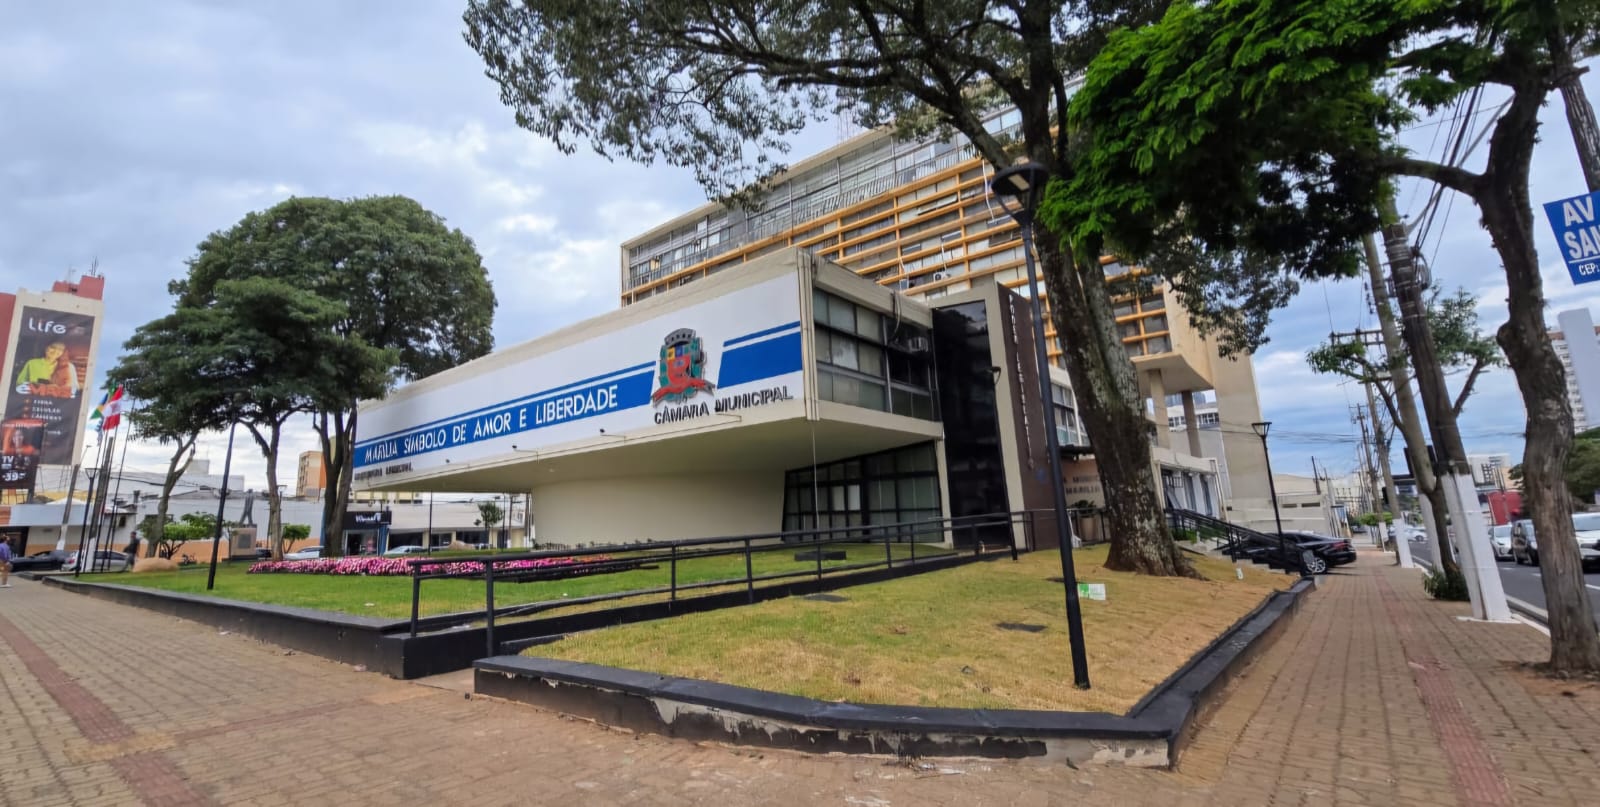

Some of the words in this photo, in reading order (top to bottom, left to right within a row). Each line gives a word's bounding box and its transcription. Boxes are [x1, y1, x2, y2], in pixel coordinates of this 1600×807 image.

[1563, 196, 1594, 227] AV
[28, 317, 67, 334] Life
[714, 386, 793, 412] MUNICIPAL
[404, 427, 447, 453] SÍMBOLO
[453, 422, 466, 443] DE
[474, 411, 511, 439] AMOR
[519, 408, 526, 427] E
[535, 384, 618, 425] LIBERDADE
